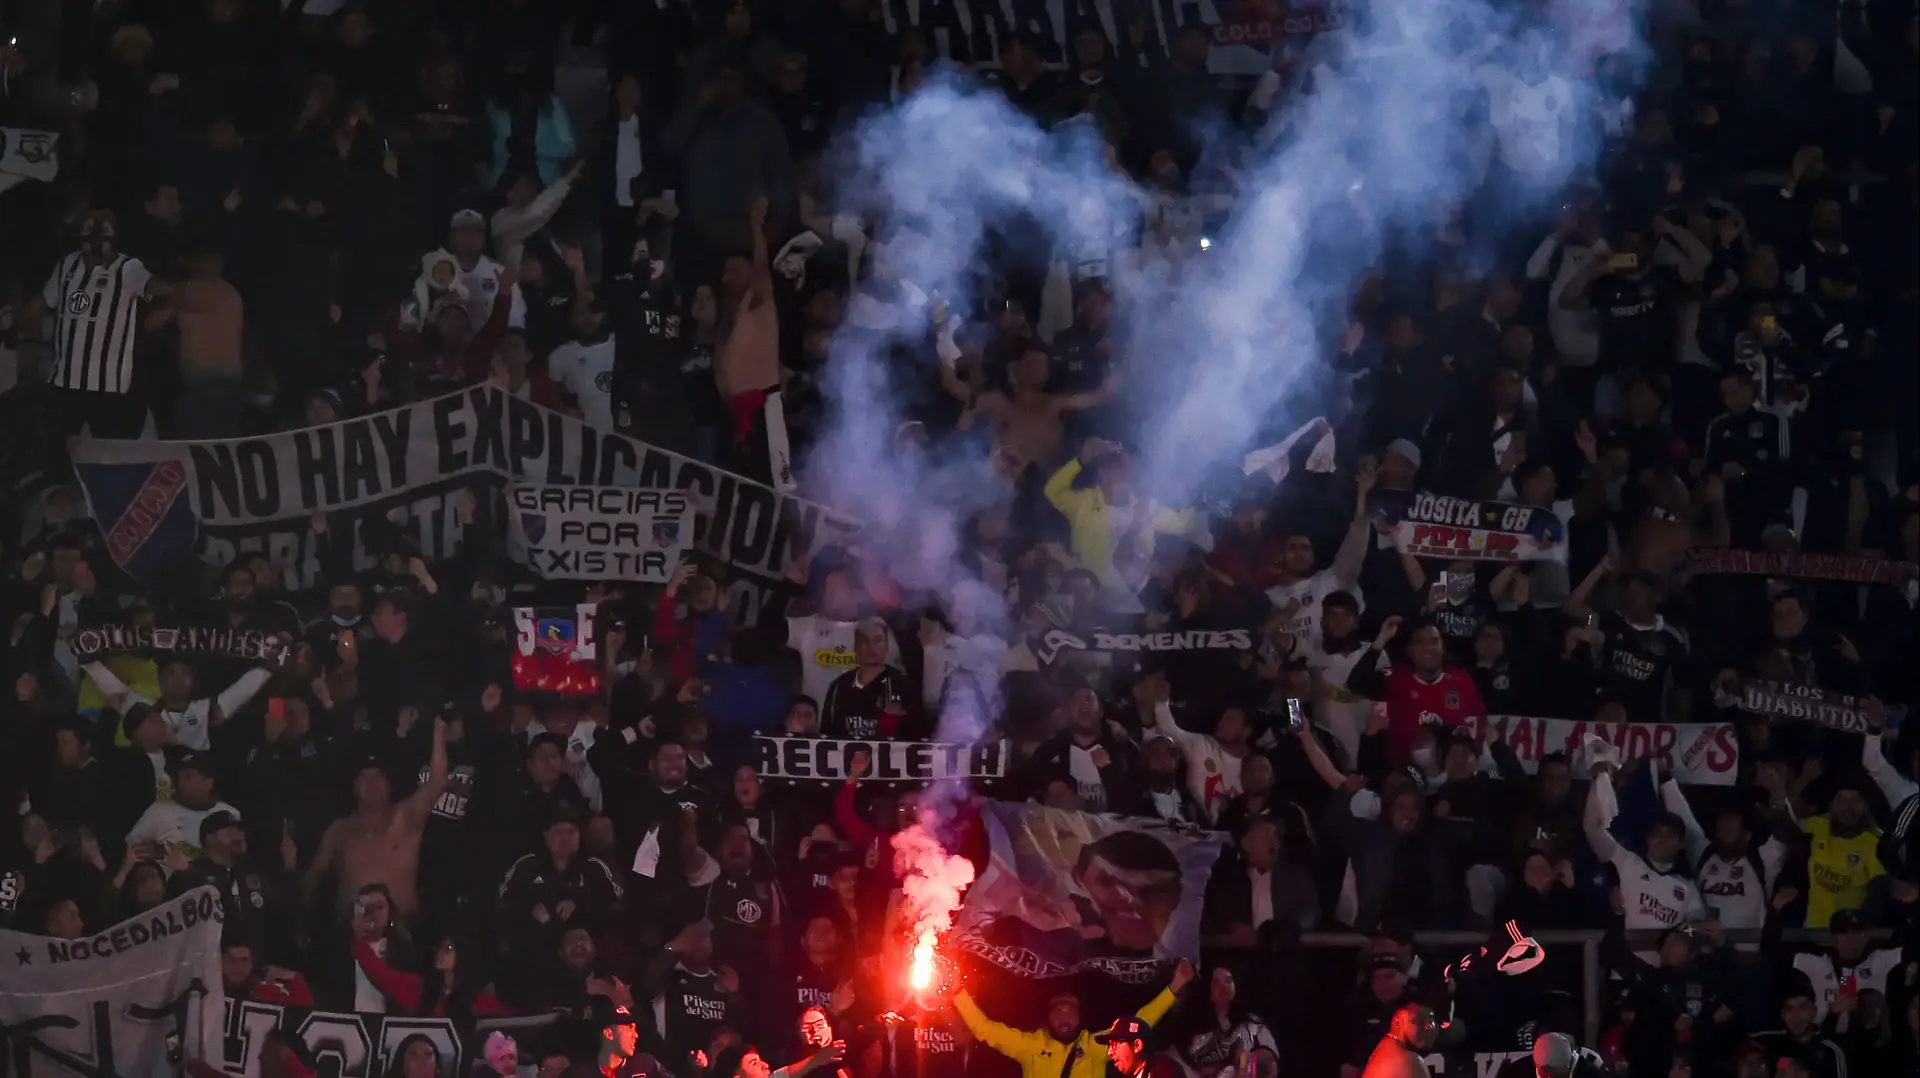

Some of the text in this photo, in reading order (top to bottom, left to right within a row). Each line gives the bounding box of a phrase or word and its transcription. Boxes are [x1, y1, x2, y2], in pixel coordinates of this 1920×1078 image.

[189, 440, 280, 518] NO
[294, 408, 411, 509] HAY
[514, 488, 686, 515] GRACIAS
[1408, 493, 1481, 527] JOSITA
[561, 521, 639, 548] POR
[527, 549, 666, 577] EXISTIR
[1093, 629, 1251, 651] DEMENTES
[1783, 682, 1825, 700] LOS
[1748, 687, 1869, 733] DIABLITOS
[845, 714, 878, 733] Pilse
[756, 737, 1000, 778] RECOLETA
[1701, 879, 1745, 896] LADA
[683, 994, 725, 1010] Pilsen
[685, 1005, 724, 1020] del Sur
[929, 1041, 955, 1053] Sur
